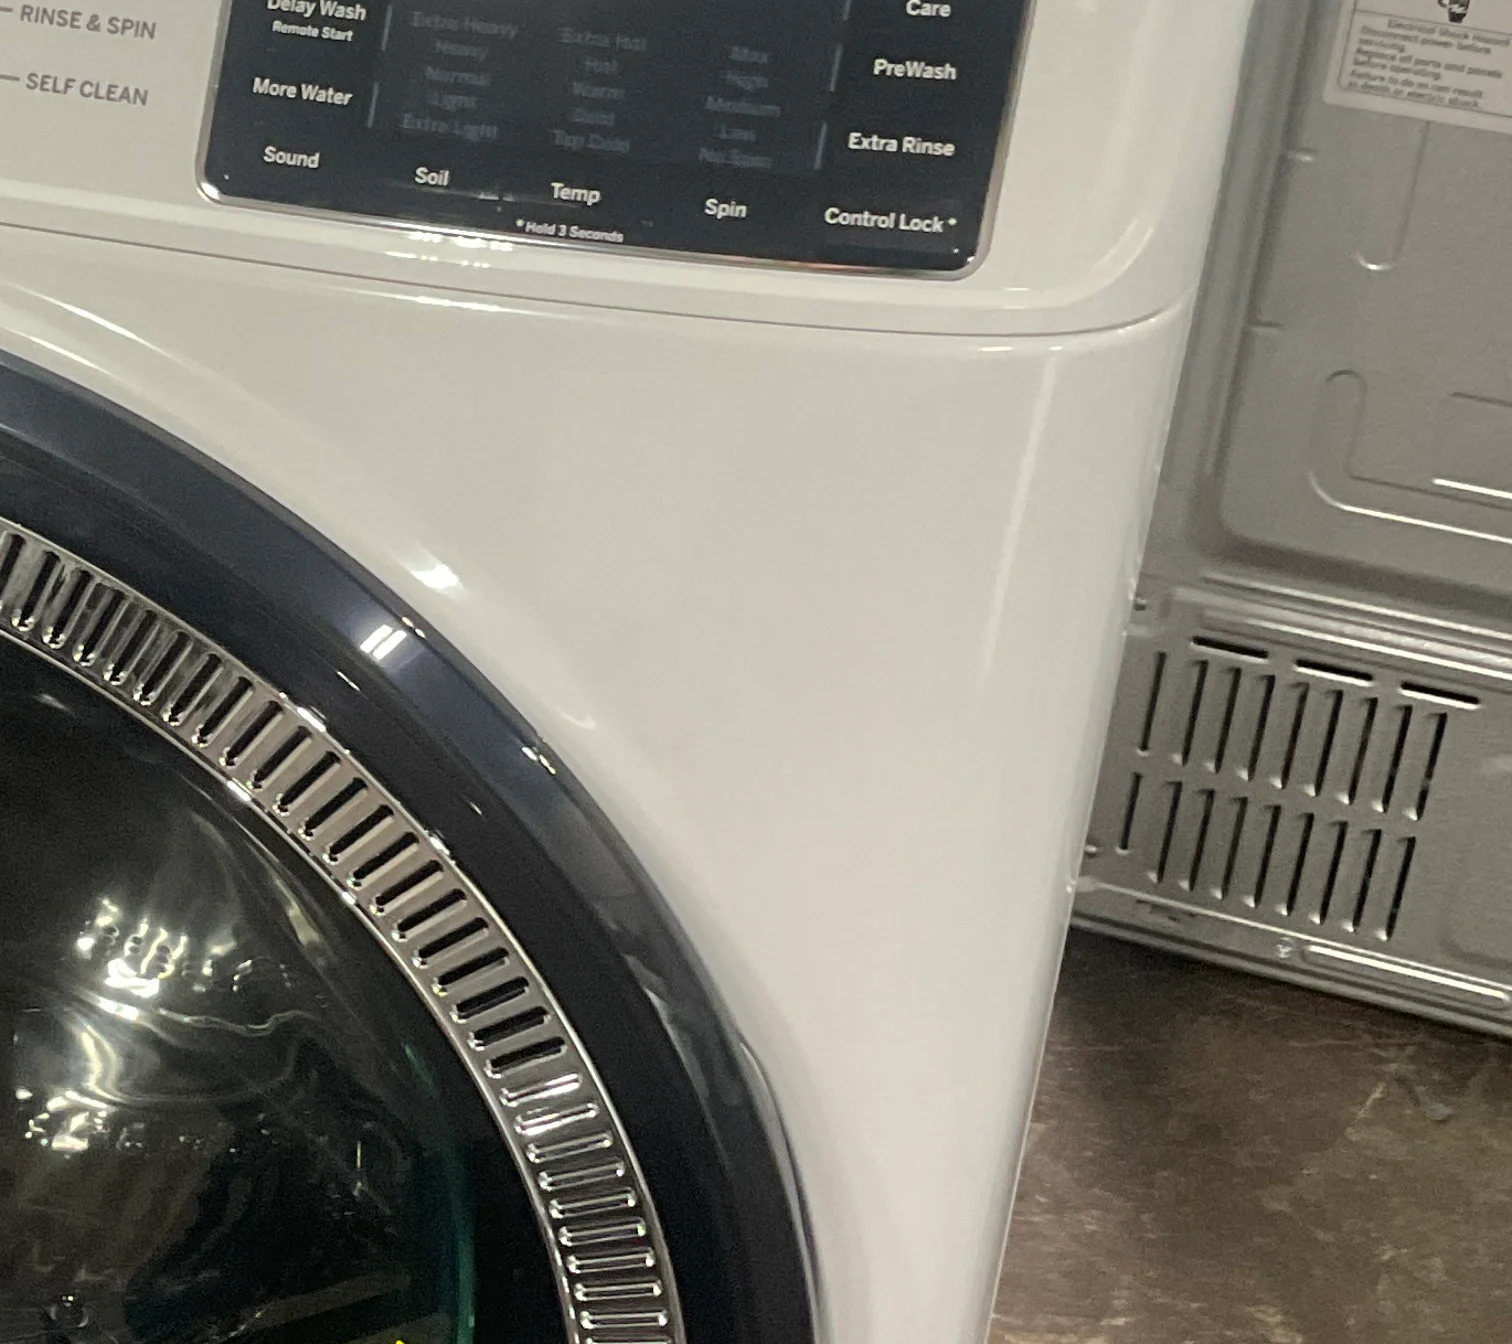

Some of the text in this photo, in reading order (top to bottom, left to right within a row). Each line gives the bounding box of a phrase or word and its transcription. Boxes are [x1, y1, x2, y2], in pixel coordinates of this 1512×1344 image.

[19, 3, 157, 40] RINSE & SPIN
[271, 19, 354, 42] Remote Start
[872, 58, 957, 80] PreWash
[25, 72, 149, 106] SELF CLEAN
[252, 75, 354, 106] More Water
[262, 144, 321, 169] Sound
[847, 131, 956, 157] Extra Rinse
[414, 165, 450, 187] Soil
[550, 181, 602, 206] Temp
[703, 196, 748, 220] Spin
[823, 206, 945, 233] Control Lock
[525, 221, 624, 244] Hold 3 Seconds
